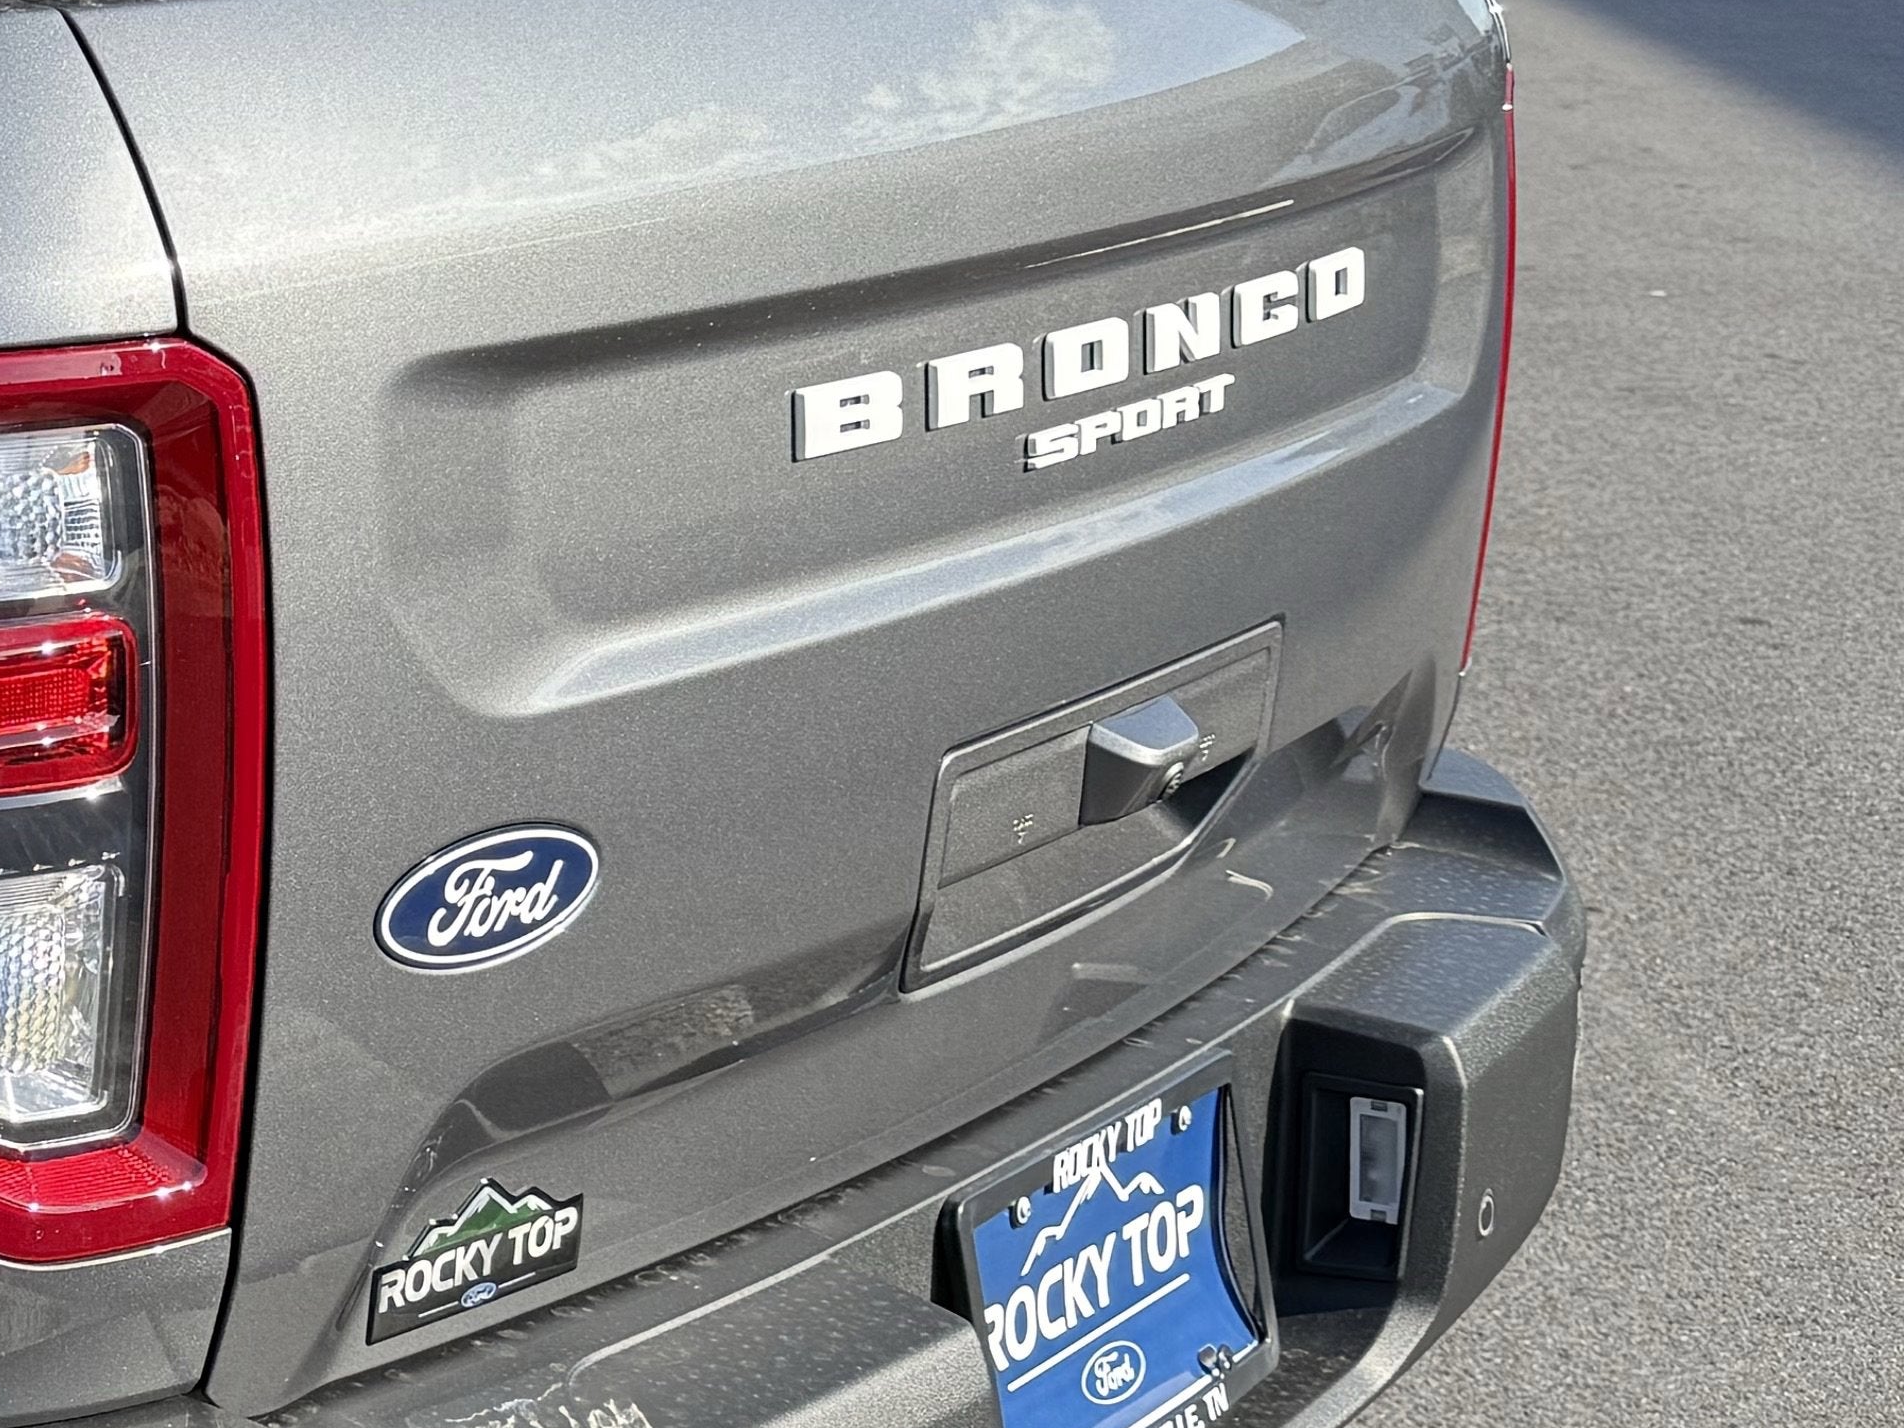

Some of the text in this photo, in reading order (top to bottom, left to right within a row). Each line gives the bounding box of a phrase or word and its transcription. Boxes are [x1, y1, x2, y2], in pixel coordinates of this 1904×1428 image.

[791, 246, 1366, 462] BRONCO
[1021, 372, 1236, 471] SPORT
[427, 850, 565, 947] Ford
[1052, 1097, 1163, 1194] ROCKY TOP
[377, 1205, 579, 1314] ROCKY TOP
[985, 1183, 1204, 1372] ROCKY TOP
[1094, 1350, 1135, 1397] Ford
[1202, 1382, 1229, 1422] TN
